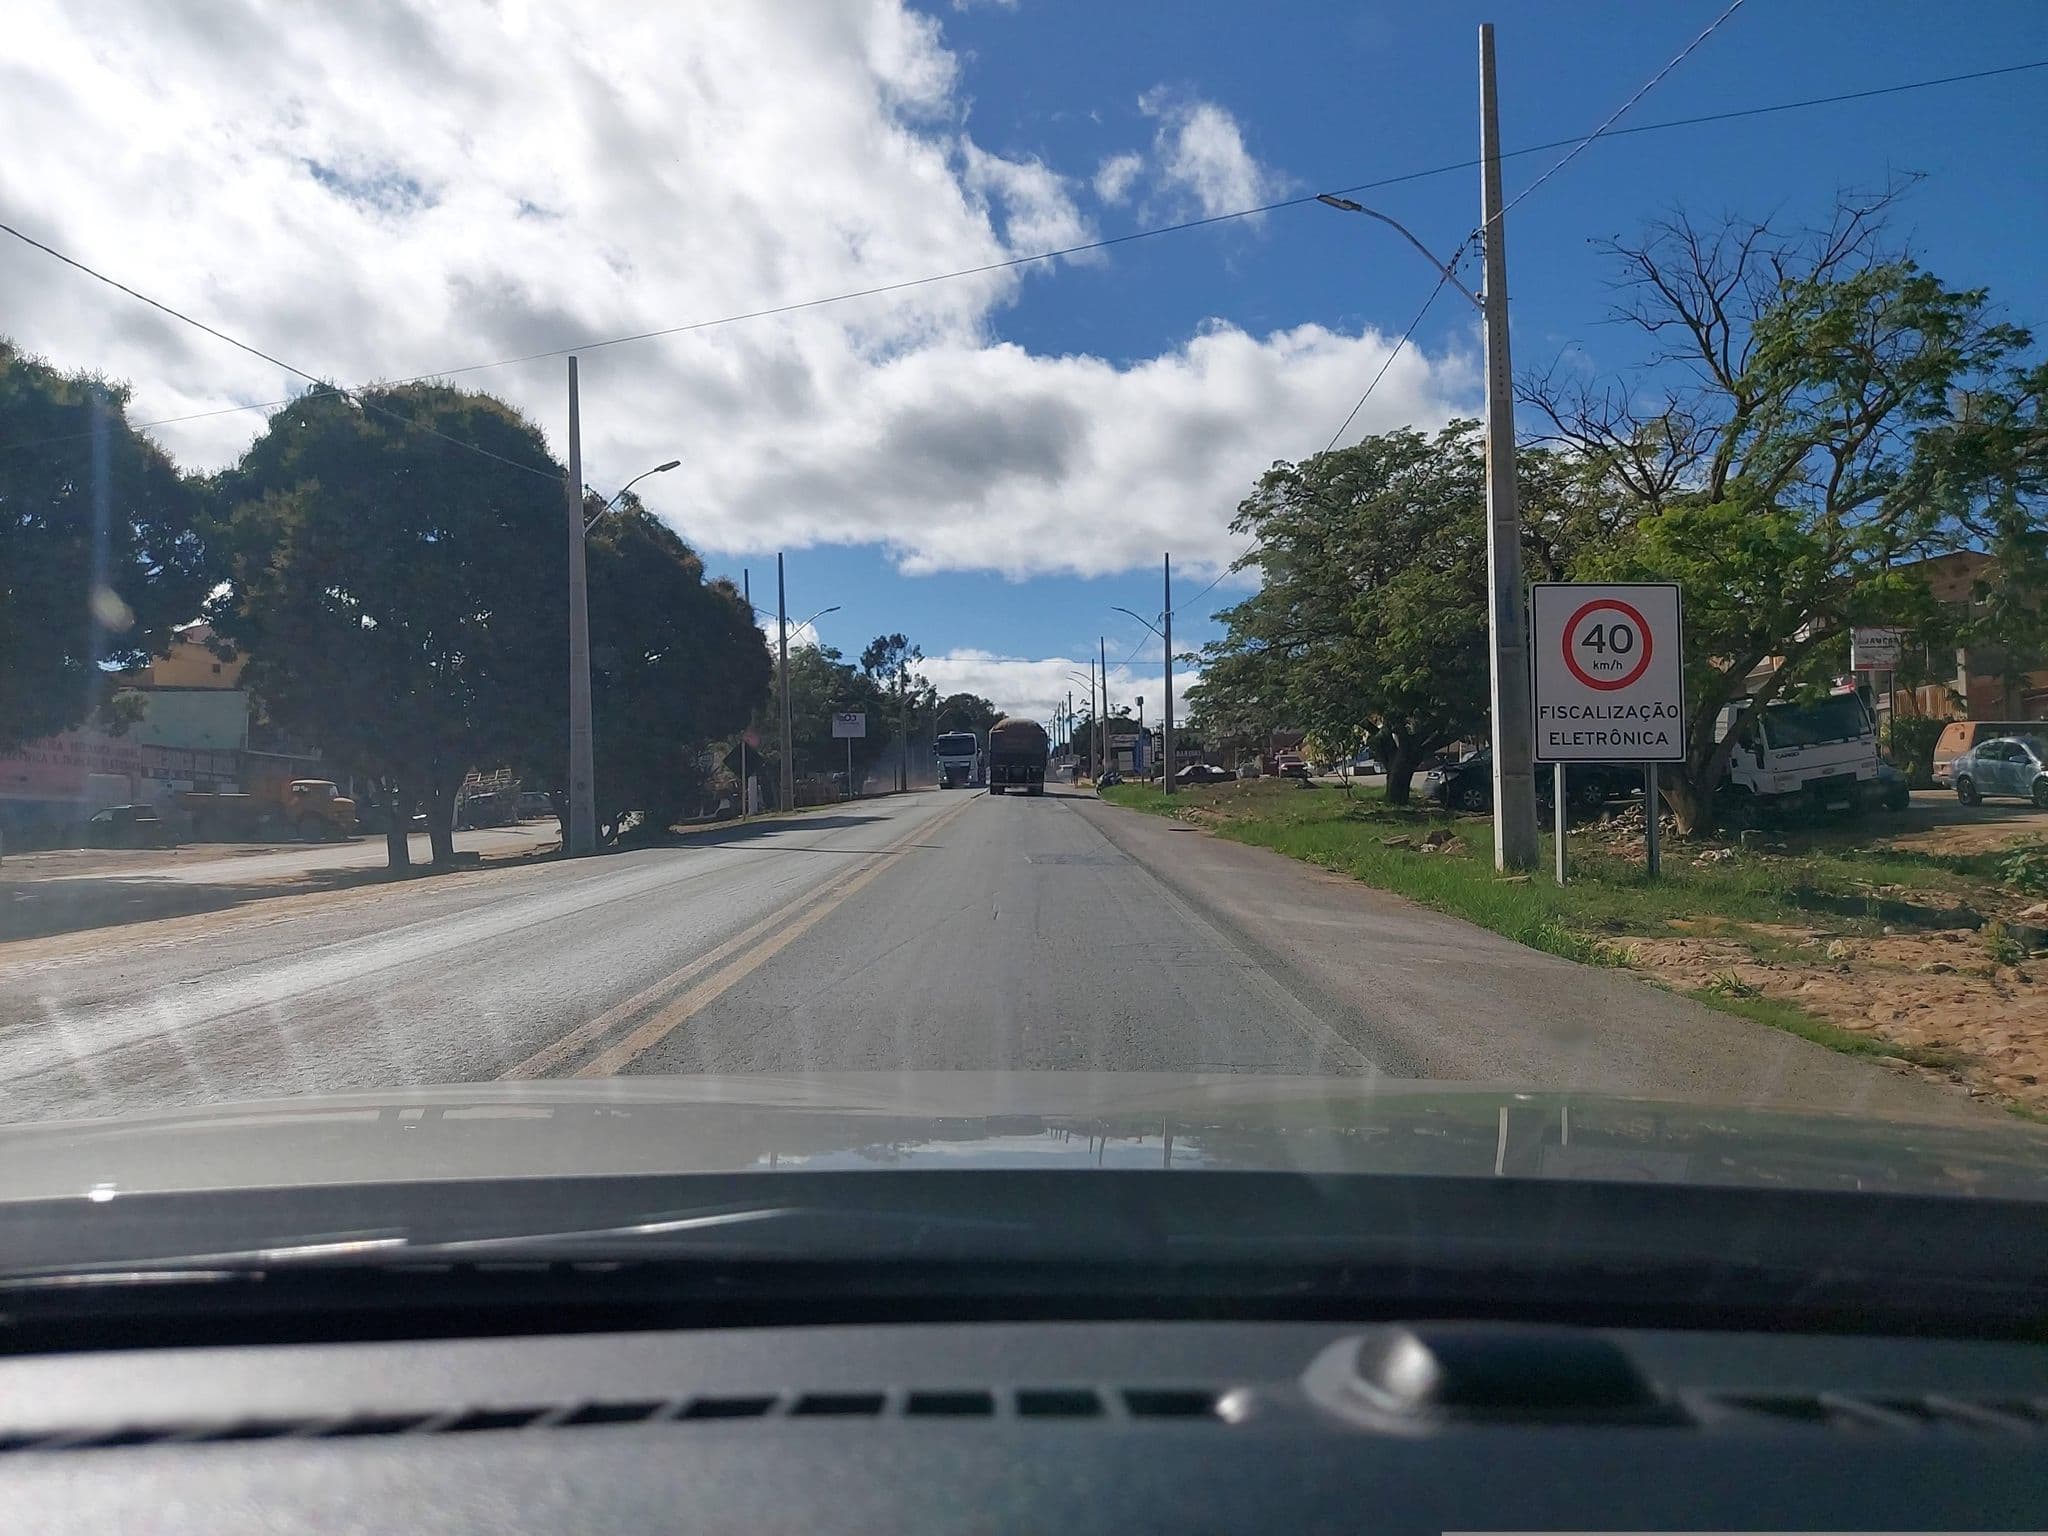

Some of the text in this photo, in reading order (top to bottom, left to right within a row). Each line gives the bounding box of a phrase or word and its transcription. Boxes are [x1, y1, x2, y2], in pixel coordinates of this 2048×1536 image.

[1581, 623, 1634, 654] 40
[1593, 659, 1623, 671] km/h
[1539, 701, 1679, 722] FISCALIZAÇÃO
[1549, 729, 1669, 746] ELETRÔNICA
